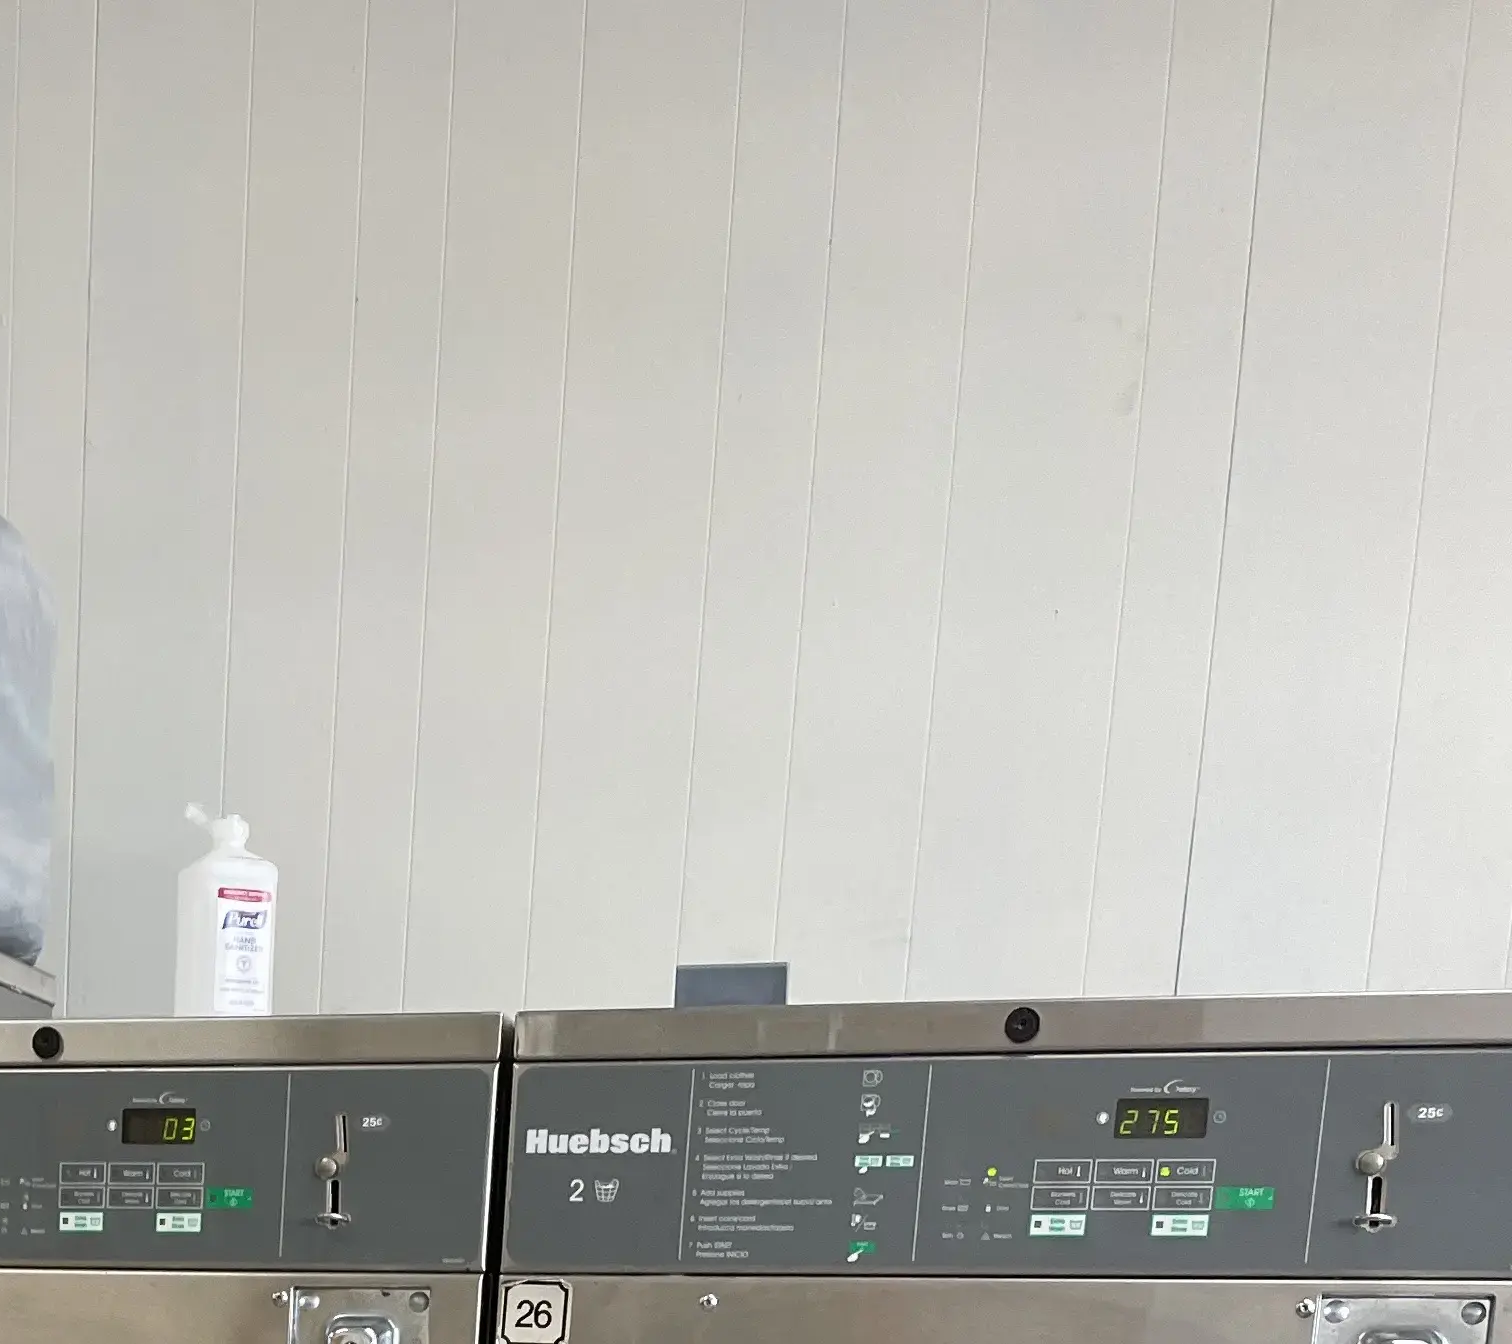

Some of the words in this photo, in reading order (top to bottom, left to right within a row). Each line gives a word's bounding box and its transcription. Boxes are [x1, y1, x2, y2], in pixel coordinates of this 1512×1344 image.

[163, 1117, 196, 1141] 03
[525, 1127, 672, 1154] Huebsch
[1176, 1166, 1199, 1175] Cold
[569, 1178, 585, 1202] 2
[1238, 1187, 1265, 1197] START
[514, 1299, 553, 1329] 26
